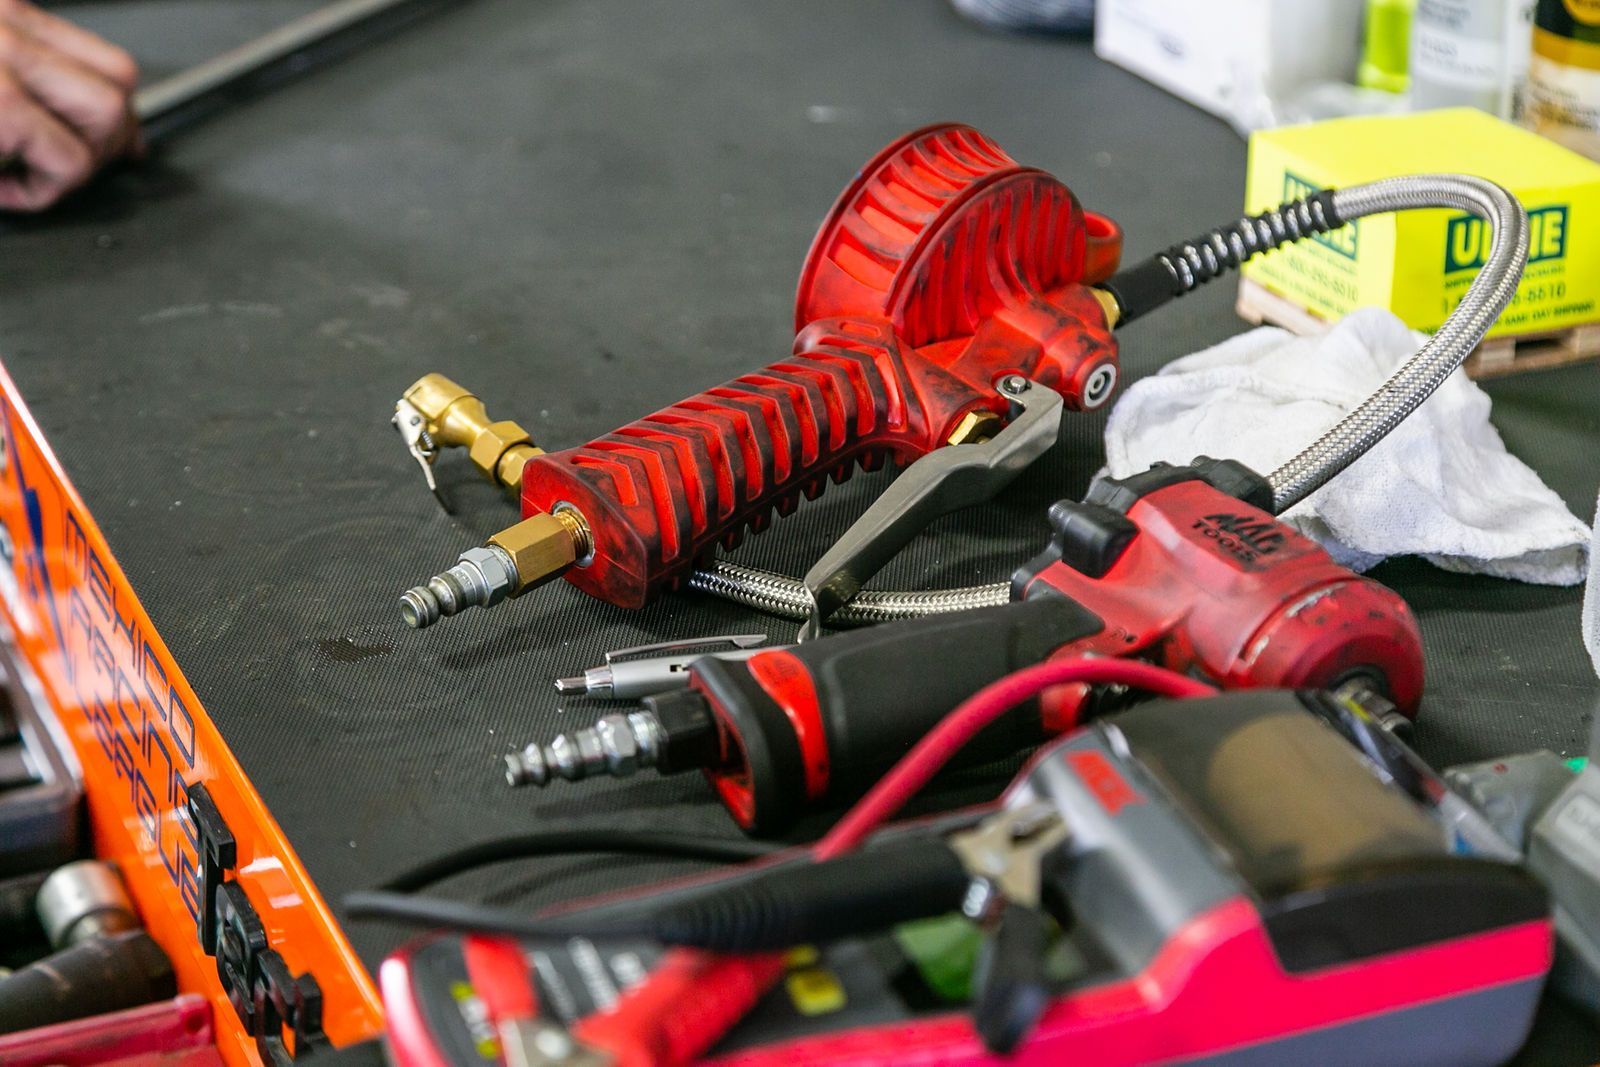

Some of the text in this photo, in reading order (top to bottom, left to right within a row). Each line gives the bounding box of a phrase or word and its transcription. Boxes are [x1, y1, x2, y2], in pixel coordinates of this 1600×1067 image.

[65, 510, 195, 770] MEXICO
[70, 585, 200, 855] RACING
[72, 653, 200, 927] LEAGUE
